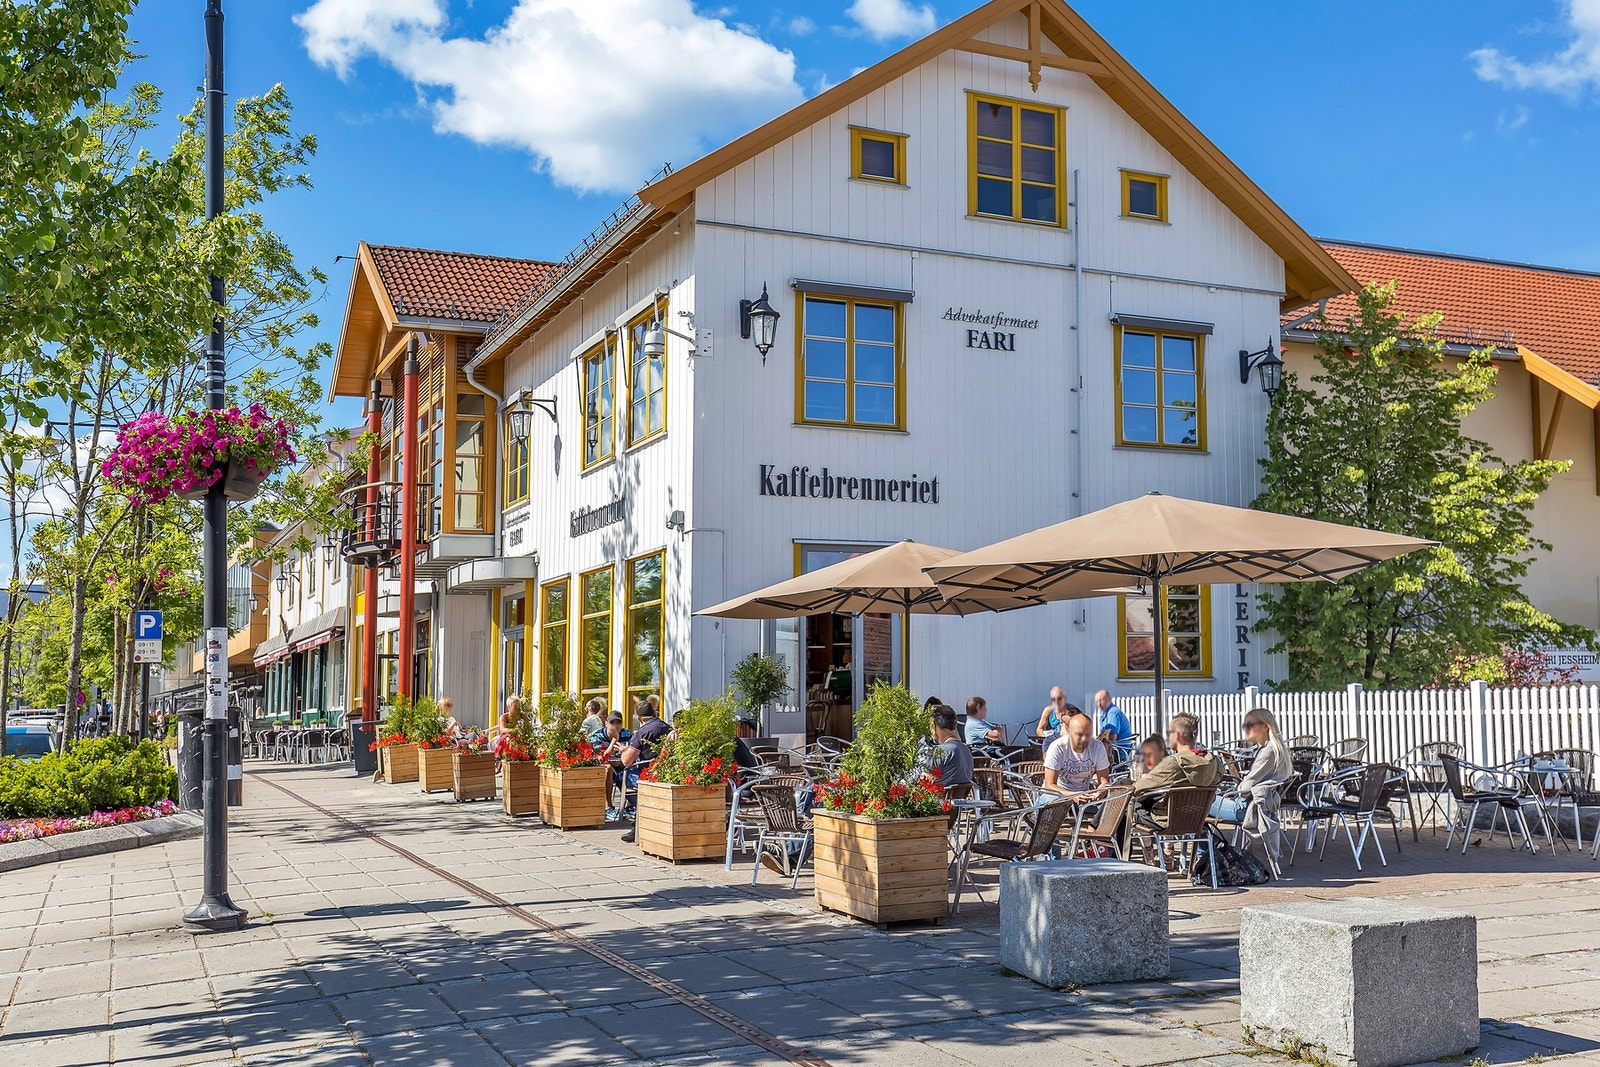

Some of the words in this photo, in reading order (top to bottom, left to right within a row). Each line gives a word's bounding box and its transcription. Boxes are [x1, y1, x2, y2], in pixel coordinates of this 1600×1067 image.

[941, 307, 1039, 329] Advokatfirmaet
[966, 329, 1016, 352] FARI
[759, 464, 940, 504] Kaffebrenneriet
[140, 615, 156, 637] P
